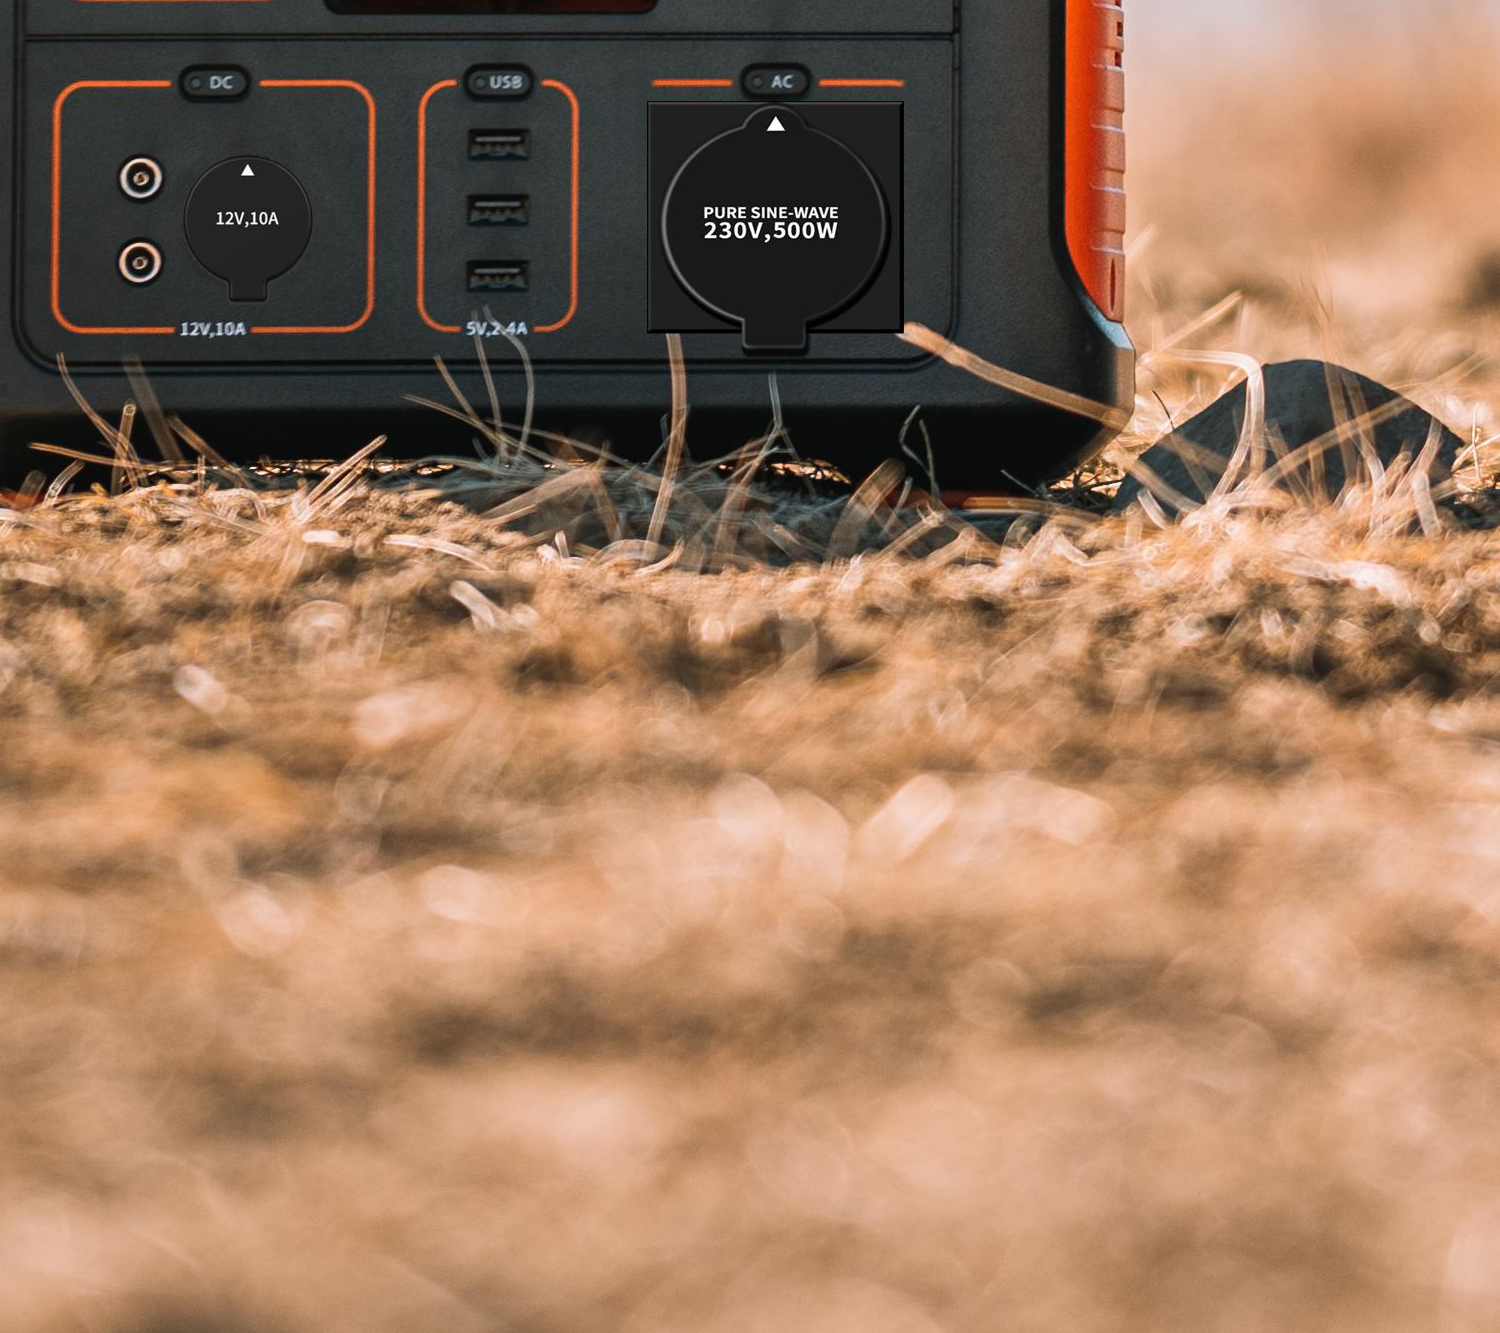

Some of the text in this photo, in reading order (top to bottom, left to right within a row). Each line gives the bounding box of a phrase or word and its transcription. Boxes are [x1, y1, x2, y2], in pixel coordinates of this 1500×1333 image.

[210, 75, 234, 90] DC
[490, 75, 522, 89] USB
[771, 75, 794, 89] AC
[216, 211, 279, 228] 12V,10A
[703, 206, 839, 219] PURE SINE-WAVE
[704, 222, 838, 243] 230V,500W
[180, 321, 247, 339] 12V,10A
[466, 320, 528, 337] 5V,24A
